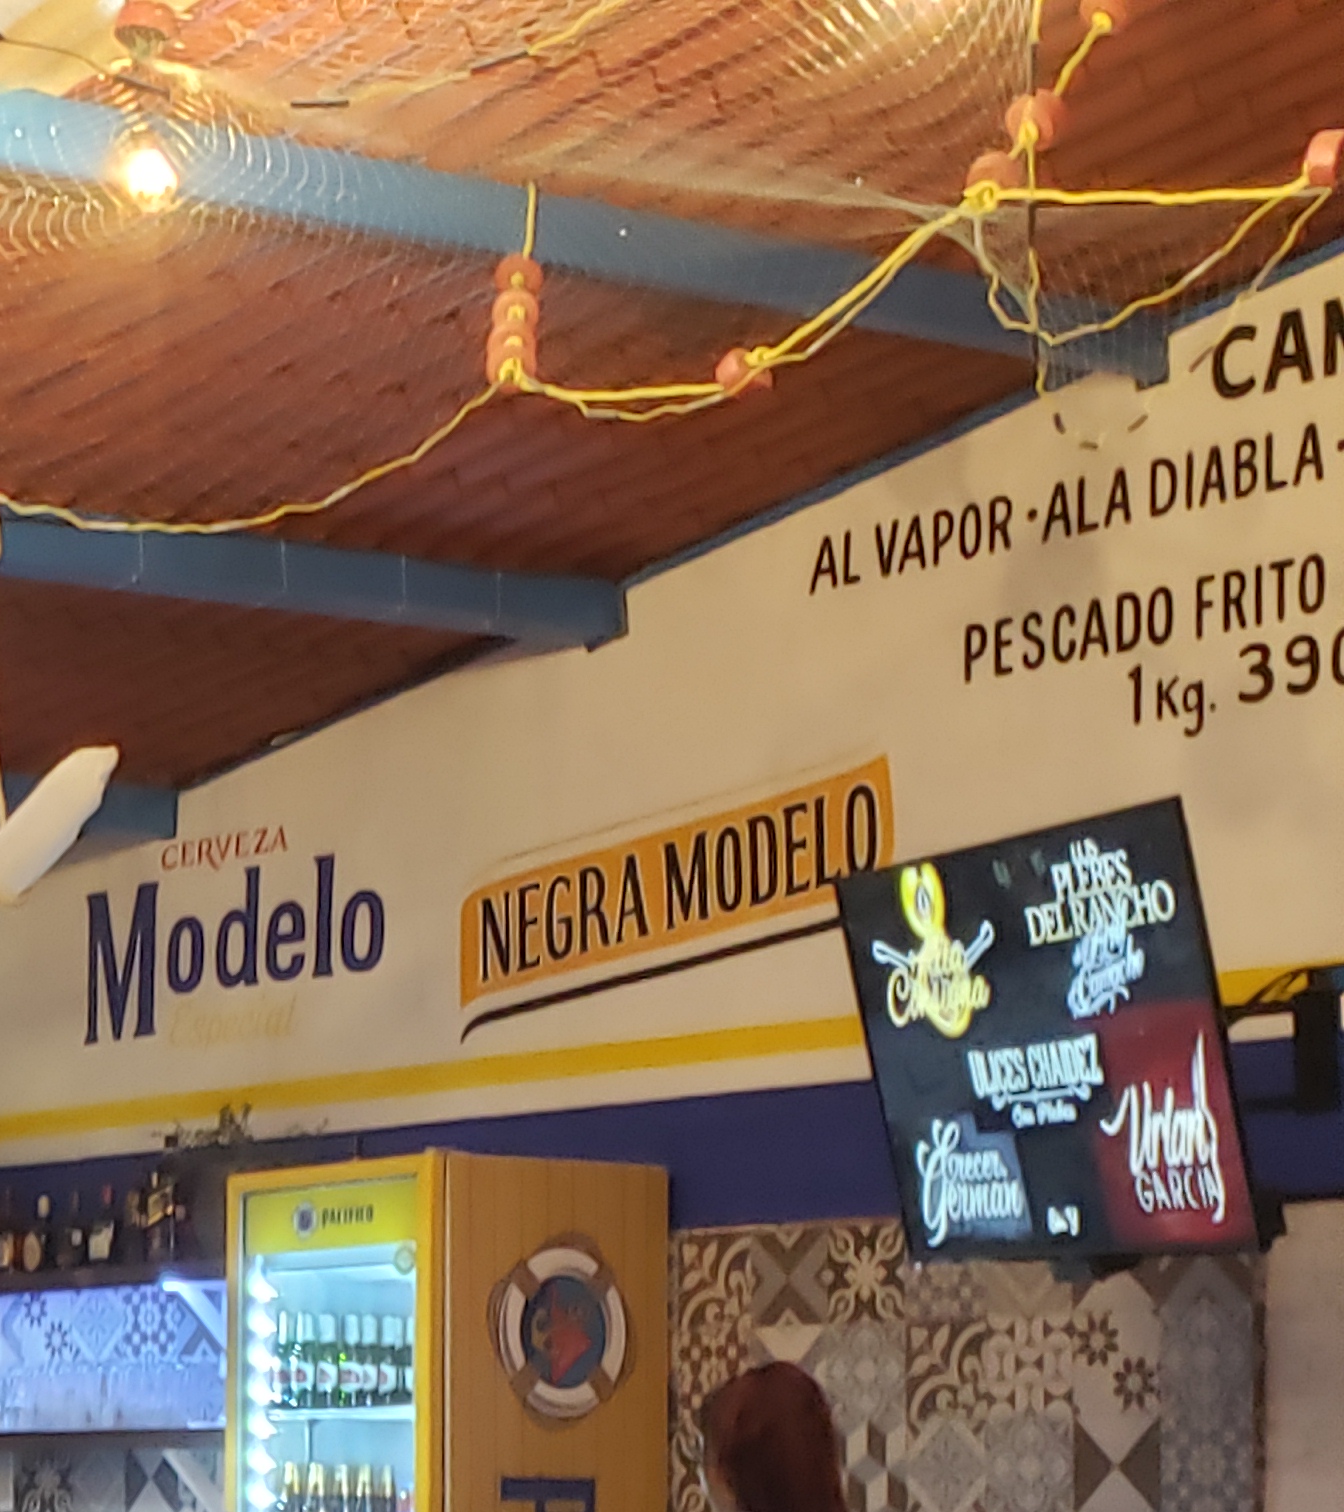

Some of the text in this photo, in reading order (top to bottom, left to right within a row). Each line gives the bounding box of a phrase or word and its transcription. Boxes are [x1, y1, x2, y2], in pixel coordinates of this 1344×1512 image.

[809, 530, 861, 596] AL
[874, 496, 1013, 579] VAPOR
[1149, 422, 1325, 518] DIABLA
[964, 553, 1327, 684] PESCADO FRITO
[161, 825, 289, 871] CERVEZA
[480, 784, 878, 984] NEGRA MODELO
[84, 853, 385, 1047] Modelo
